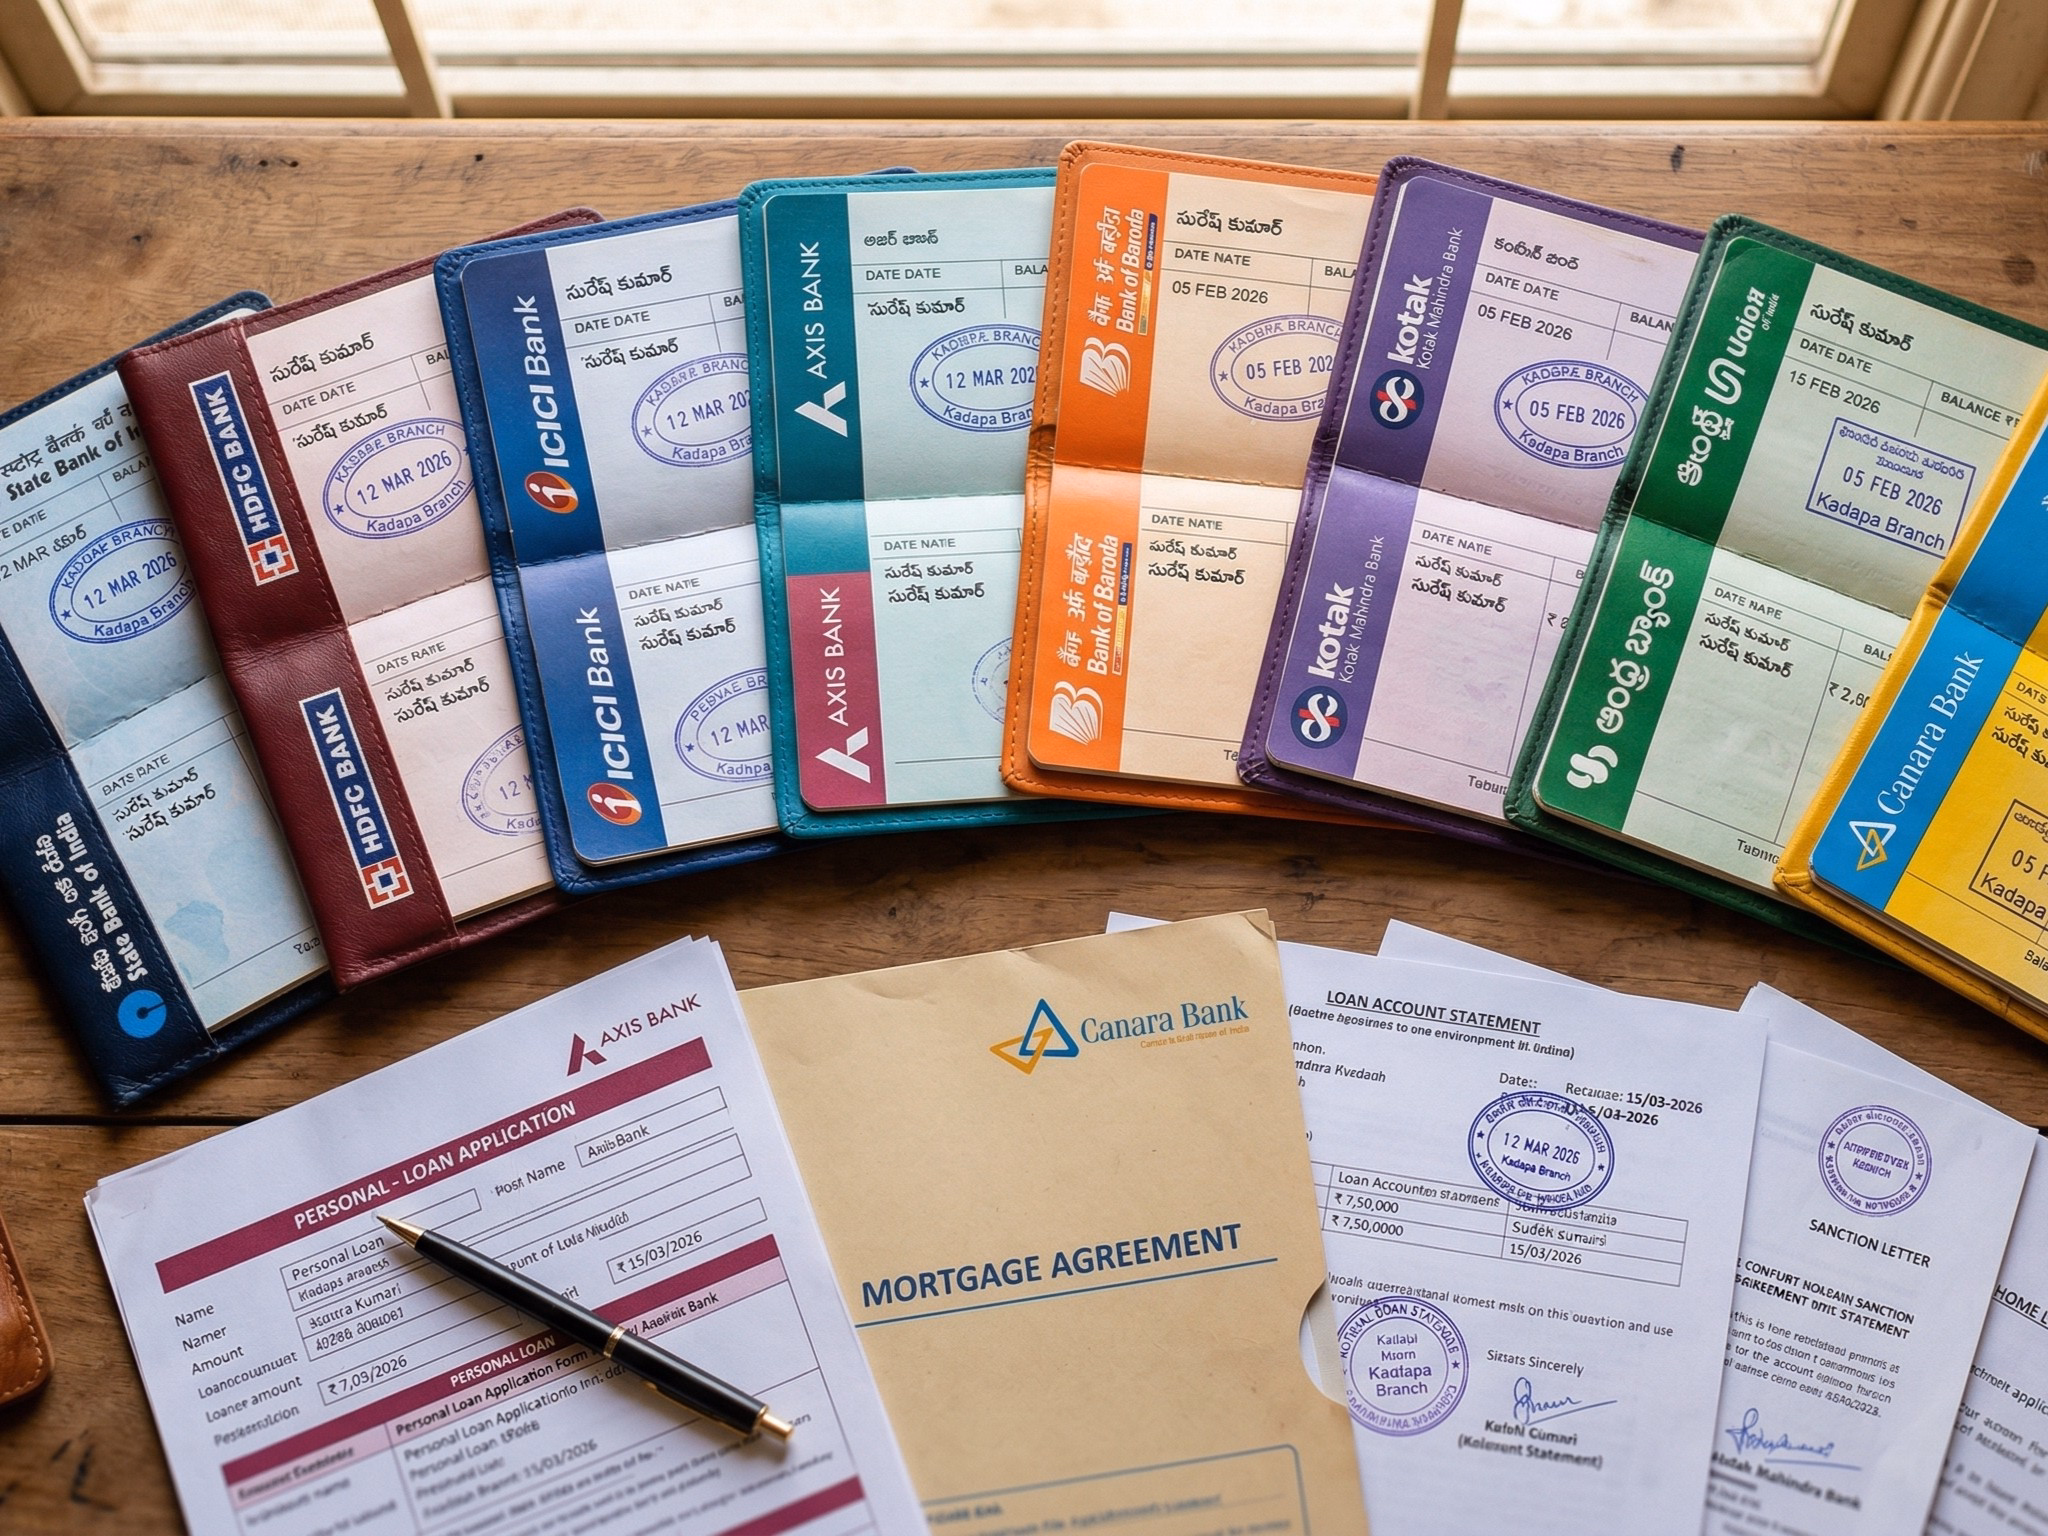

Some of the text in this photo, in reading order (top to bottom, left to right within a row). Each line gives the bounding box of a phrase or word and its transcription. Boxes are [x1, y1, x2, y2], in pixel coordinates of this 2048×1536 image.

[1176, 209, 1284, 237] సురేష్ కుమార్
[1174, 248, 1210, 262] DATE
[566, 265, 673, 302] సురేష్ కుమార్
[866, 268, 942, 281] DATE DATE
[1115, 208, 1144, 334] Bank of Baroda
[1485, 272, 1559, 301] DATE DATE
[868, 296, 966, 317] సురేష్ కుమార్
[1172, 280, 1269, 305] 05 FEB 2026
[1415, 227, 1464, 370] Kotak Mahindra Bank
[574, 310, 651, 334] DATE DATE
[799, 241, 828, 380] AXIS BANK
[1386, 274, 1433, 365] kotak
[1477, 304, 1574, 341] 05 FEB 2026
[1810, 302, 1914, 353] సురేష్ కుమార్
[269, 331, 375, 383] సురేష్ కుమార్
[1246, 359, 1302, 380] 05 FEB
[1799, 338, 1873, 374] DATE DATE
[512, 295, 570, 468] ICICI Bank
[946, 368, 1004, 390] 12 MAR
[1788, 370, 1882, 415] 15 FEB 2026
[282, 381, 356, 415] DATE DATE
[1243, 396, 1298, 417] Kadapa
[1940, 391, 2003, 424] BALANCE
[666, 399, 725, 430] 12 MAR
[943, 404, 998, 426] Kadapa
[1529, 400, 1626, 430] 05 FEB 2026
[6, 433, 126, 501] State Bank of
[205, 386, 271, 535] HDFC BANK
[672, 444, 727, 462] Kadapa
[1573, 445, 1625, 463] Branch
[356, 449, 452, 505] 12 2026
[1842, 466, 1944, 516] 05 FEB 2026
[366, 512, 422, 533] Kadapa
[1152, 514, 1185, 527] DATE
[1815, 491, 1946, 551] Kadapa Branch
[884, 540, 918, 552] DATE
[1421, 529, 1455, 546] DATE
[111, 551, 178, 598] MAR 2026
[1356, 535, 1385, 642] Mahindra Bank
[628, 584, 662, 600] DATE
[888, 582, 986, 604] సురేష్ కుమార్
[1086, 534, 1119, 676] Bank of Baroda
[1713, 587, 1747, 608] DATE
[94, 614, 150, 638] Kadapa
[1307, 582, 1354, 679] kotak
[819, 586, 850, 727] AXIS BANK
[576, 606, 634, 780] ICICI Bank
[710, 726, 732, 746] 12
[1876, 650, 1985, 817] Canara Bank
[315, 704, 384, 855] HDFC BANK
[2011, 849, 2037, 873] 05
[56, 812, 148, 982] State Bank of India
[599, 993, 702, 1048] AXIS BANK
[1080, 1011, 1174, 1045] Canara
[1180, 996, 1249, 1028] Bank
[1327, 990, 1541, 1034] LOAN ACCOUNT STATEMENT
[1396, 1022, 1432, 1037] to one
[1504, 1132, 1581, 1165] 12 2026
[293, 1100, 577, 1230] PERSONAL LOAN APPLICATION
[526, 1160, 566, 1184] Name
[1339, 1172, 1370, 1186] Loan
[1345, 1194, 1400, 1214] 7,50,000
[292, 1236, 386, 1281] Personal Loan
[627, 1231, 703, 1270] 15/03/2026
[1510, 1243, 1583, 1264] 15/03/2026
[1809, 1218, 1931, 1269] SANCTION LETTER
[862, 1223, 1243, 1308] MORTGAGE AGREEMENT
[174, 1304, 215, 1327] Name
[687, 1291, 719, 1313] Bank
[1854, 1298, 1915, 1323] SANCTION
[1528, 1304, 1674, 1338] on this and use
[1839, 1309, 1911, 1340] STATEMENT
[181, 1325, 228, 1352] Namer
[190, 1346, 245, 1376] Amount
[450, 1335, 557, 1387] PERSONAL LOAN
[1528, 1355, 1585, 1377] Sincerely
[1773, 1355, 1814, 1378] account
[395, 1347, 589, 1436] Personal Loan Application Form
[1376, 1382, 1429, 1398] Branch
[461, 1418, 494, 1437] Loan
